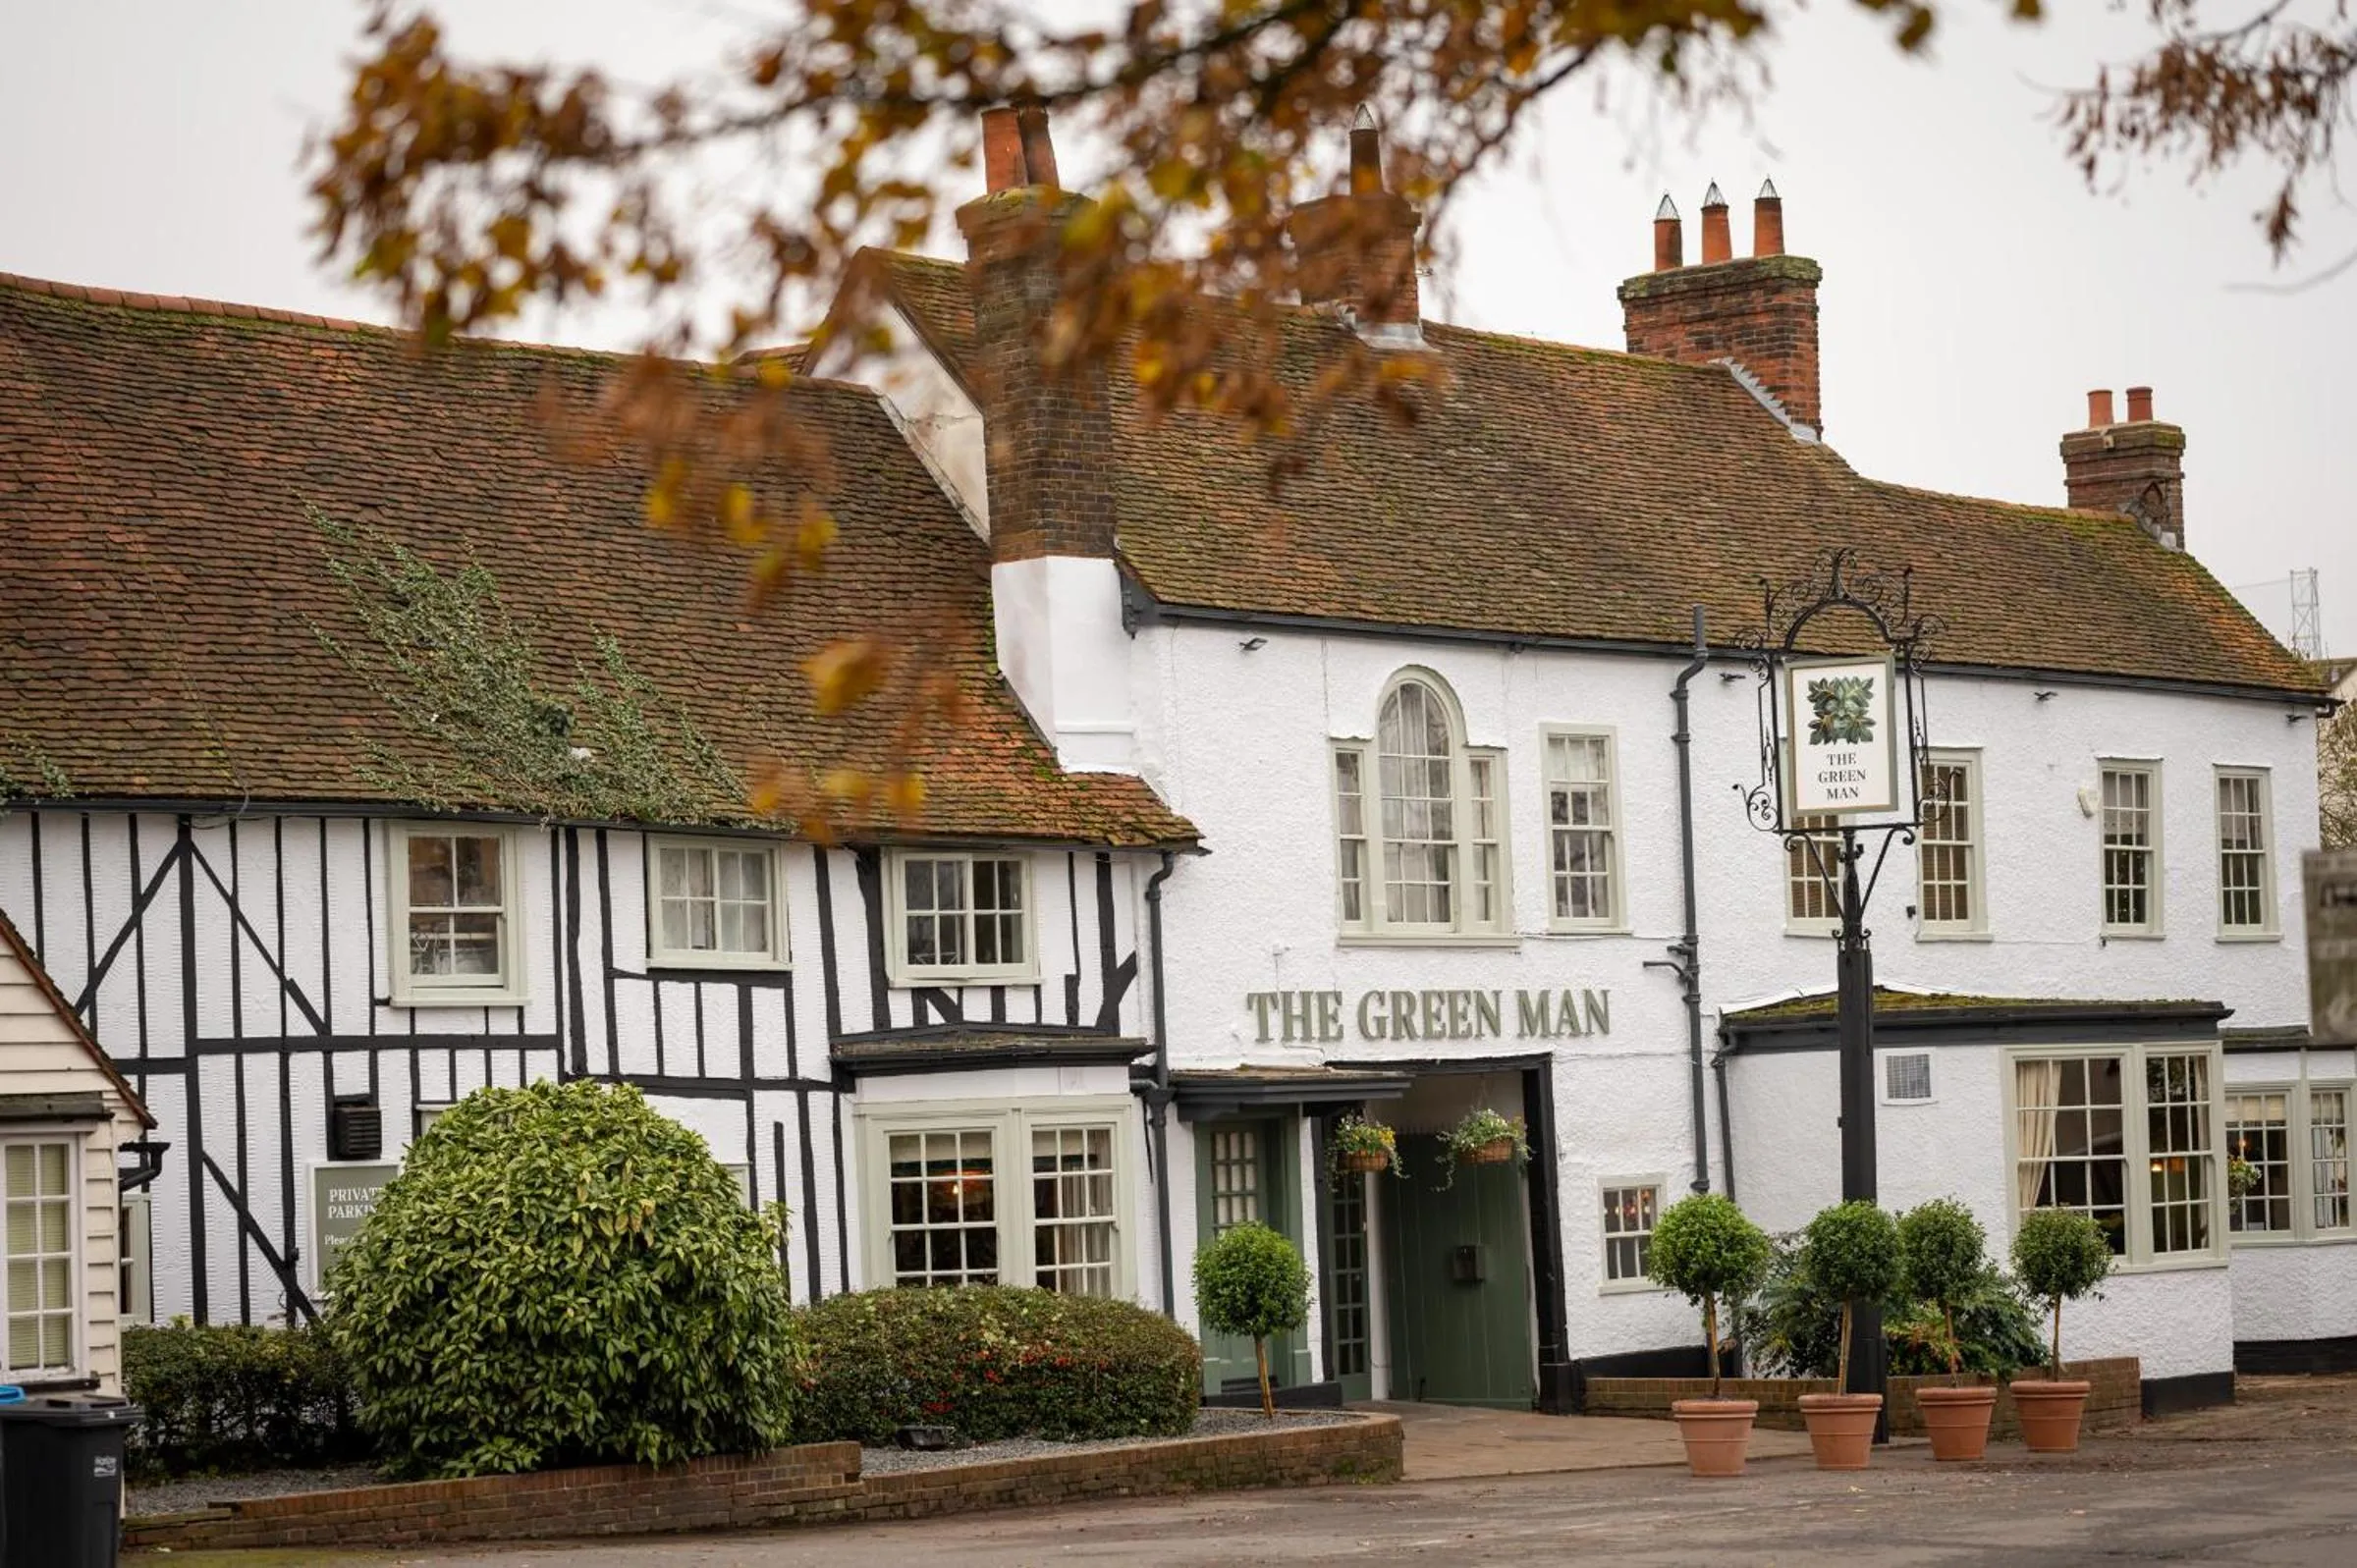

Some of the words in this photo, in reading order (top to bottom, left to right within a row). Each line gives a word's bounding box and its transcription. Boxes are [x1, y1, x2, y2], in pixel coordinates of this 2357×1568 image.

[1827, 753, 1856, 765] THE
[1818, 769, 1866, 784] GREEN
[1826, 786, 1858, 799] MAN
[1246, 990, 1344, 1043] THE
[1357, 989, 1503, 1042] GREEN
[1516, 989, 1611, 1039] MAN
[329, 1187, 381, 1202] PRIVAT
[327, 1204, 377, 1218] PARKIN
